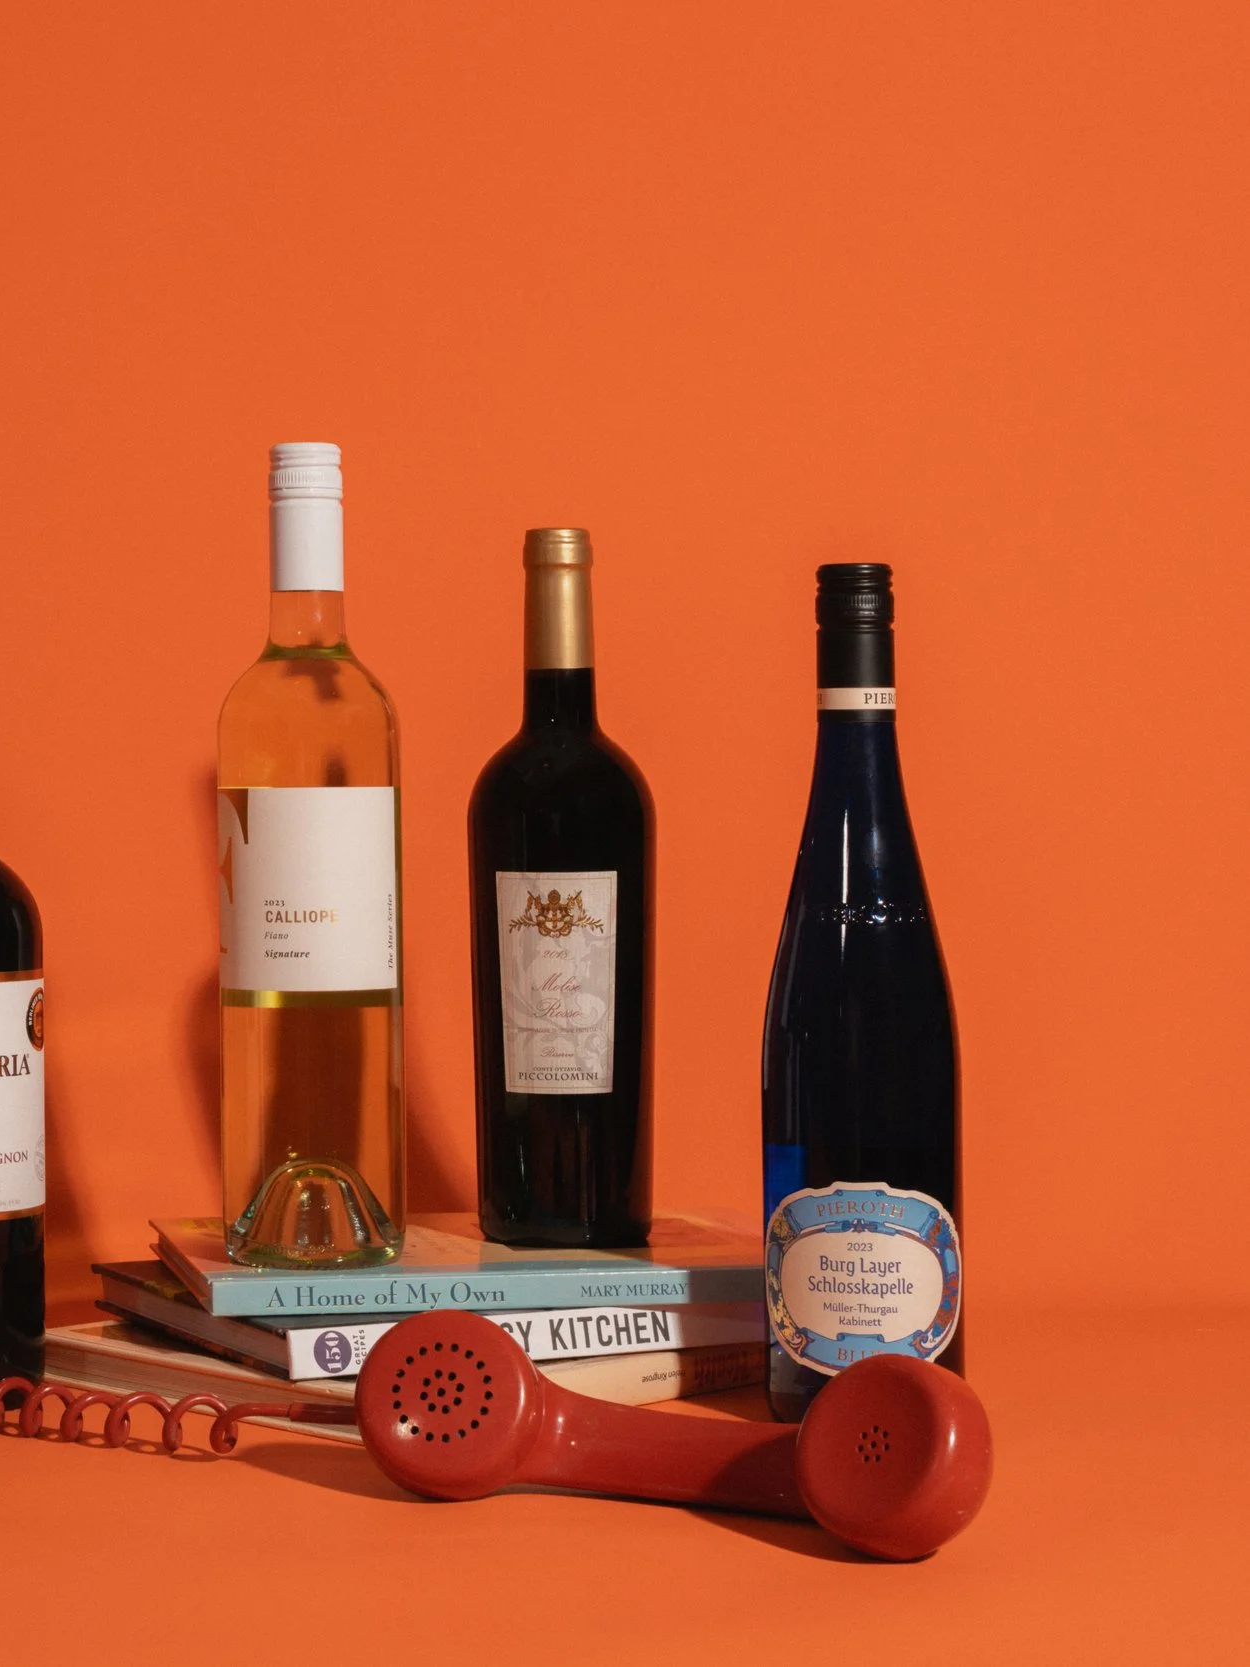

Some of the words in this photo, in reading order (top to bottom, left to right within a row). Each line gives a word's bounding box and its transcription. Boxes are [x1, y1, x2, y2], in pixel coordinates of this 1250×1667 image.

[863, 692, 895, 706] PIER
[265, 910, 338, 923] CALLIOPE
[264, 932, 289, 940] Fiano
[264, 950, 310, 960] Signature
[533, 997, 582, 1018] Rosso
[518, 1072, 599, 1082] PICCOLOMINI
[816, 1200, 905, 1219] PIEROTH
[847, 1242, 873, 1252] 2023
[820, 1256, 855, 1276] Burg
[860, 1257, 902, 1277] Layer
[266, 1286, 286, 1308] A
[294, 1285, 365, 1308] Home
[374, 1280, 398, 1305] of
[406, 1283, 441, 1309] My
[450, 1282, 505, 1304] Own
[581, 1285, 622, 1298] MARY
[626, 1282, 690, 1297] MURRAY
[808, 1275, 914, 1299] Schlosskapelle
[823, 1302, 898, 1316] Müller-Thurgau
[839, 1316, 882, 1327] Kabinett
[550, 1310, 671, 1351] KITCHEN
[325, 1332, 343, 1372] 150
[353, 1334, 361, 1365] GREAT
